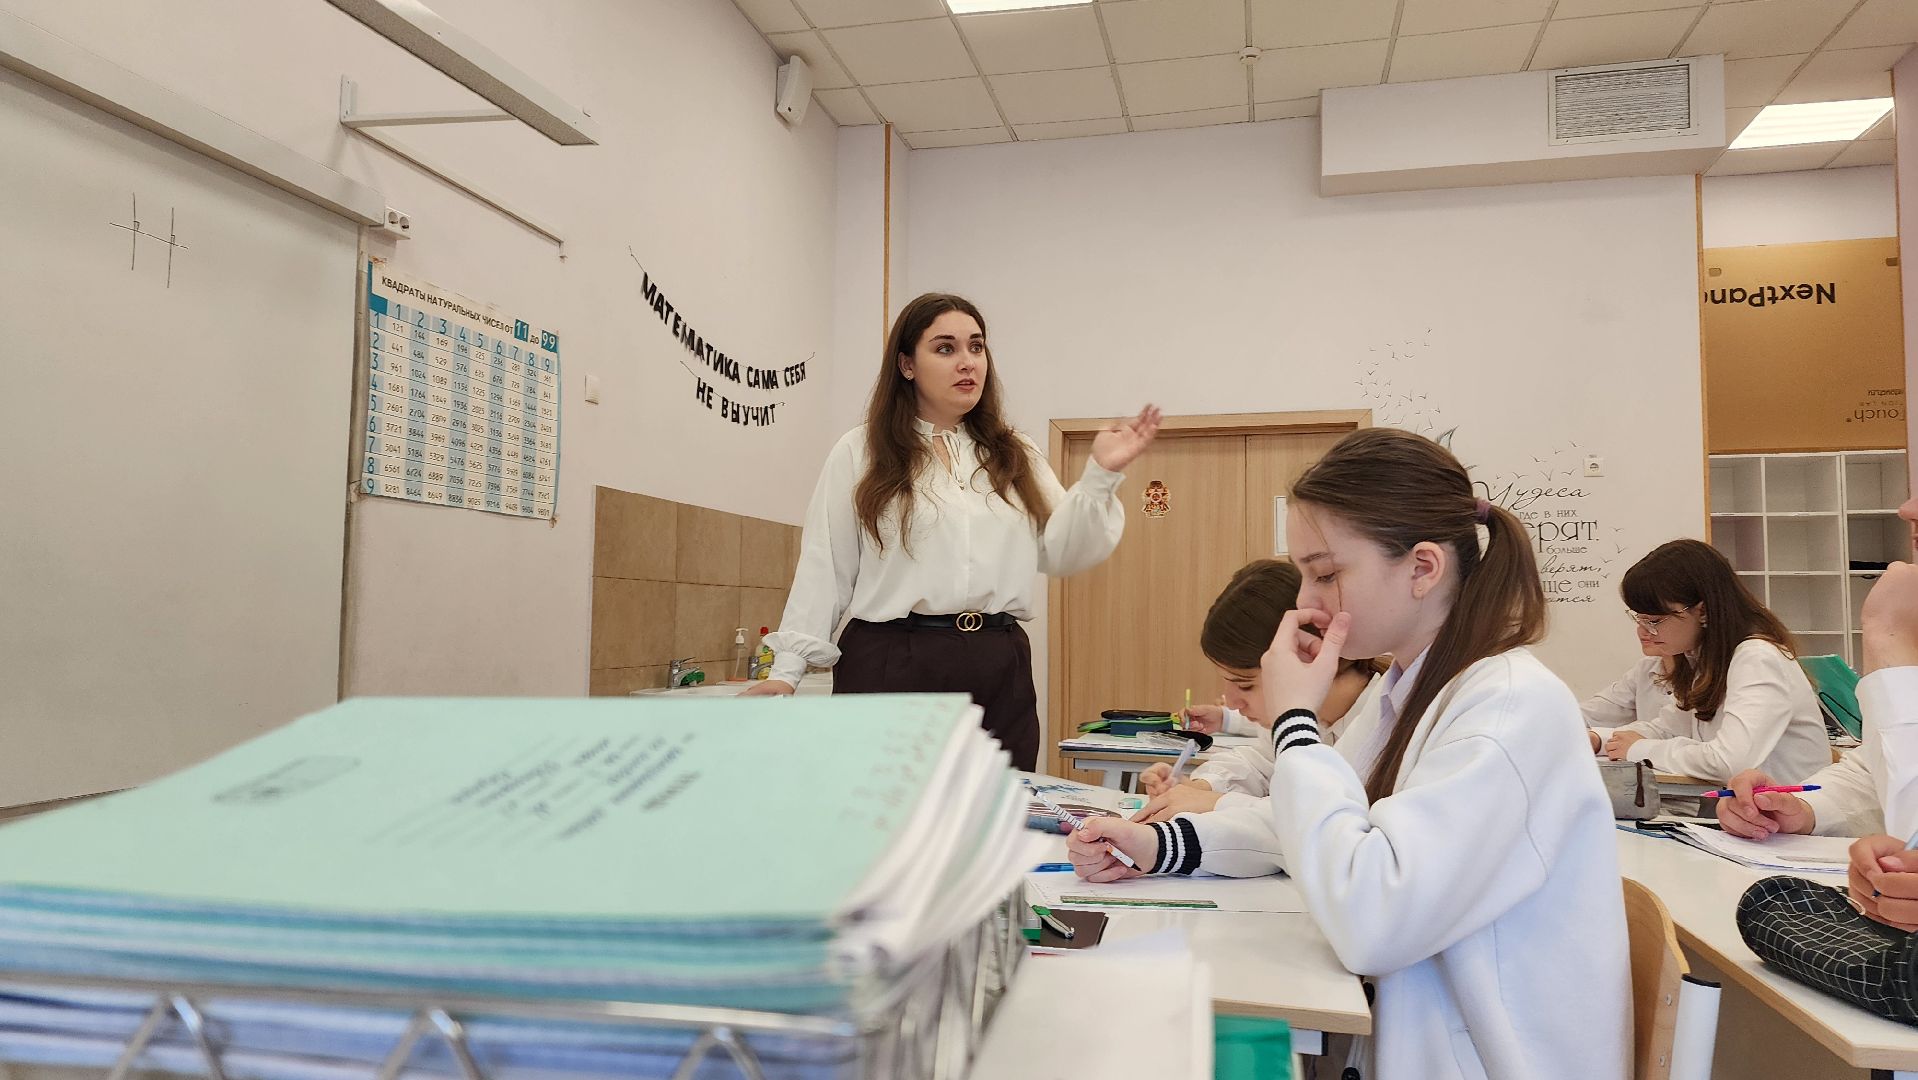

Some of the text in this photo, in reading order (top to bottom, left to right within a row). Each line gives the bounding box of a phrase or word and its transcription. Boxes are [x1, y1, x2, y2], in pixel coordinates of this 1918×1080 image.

[382, 276, 555, 351] КВАДРАТЫ НАТУРАЛЬНЫХ ЧИСЕЛ ОТ 11 ДО 99
[375, 313, 380, 328] 1
[393, 323, 403, 333] 121
[414, 330, 425, 340] 144
[436, 338, 448, 347] 169
[457, 344, 467, 354] 196
[527, 368, 537, 377] 324
[641, 272, 806, 390] МАТЕМАТИКА САМА СЕБЯ
[372, 353, 379, 369] 3
[391, 363, 402, 372] 961
[412, 368, 426, 379] 1024
[454, 382, 468, 392] 1156
[473, 386, 485, 397] 1225
[373, 332, 379, 349] 2
[392, 342, 403, 352] 441
[413, 350, 424, 359] 484
[435, 357, 447, 366] 529
[456, 363, 467, 372] 576
[493, 375, 502, 384] 676
[512, 380, 520, 389] 729
[371, 374, 378, 390] 4
[388, 383, 403, 393] 1681
[410, 388, 426, 399] 1764
[454, 400, 468, 410] 1936
[696, 377, 775, 426] НЕ ВЫУЧИТ
[371, 394, 377, 411] 5
[386, 403, 403, 413] 2601
[409, 409, 425, 418] 2704
[452, 419, 467, 428] 2916
[1854, 409, 1904, 422] ouch
[369, 416, 376, 432] 6
[386, 423, 402, 433] 3721
[451, 438, 466, 448] 4096
[368, 436, 375, 453] 7
[385, 444, 400, 453] 5041
[408, 448, 422, 457] 5184
[429, 453, 444, 462] 5329
[450, 456, 464, 466] 5476
[367, 478, 374, 495] 9
[368, 457, 375, 473] 8
[384, 464, 400, 473] 6561
[449, 475, 464, 485] 7056
[1472, 481, 1592, 511] Чудеса
[1546, 545, 1587, 554] больше
[1542, 580, 1572, 594] ще
